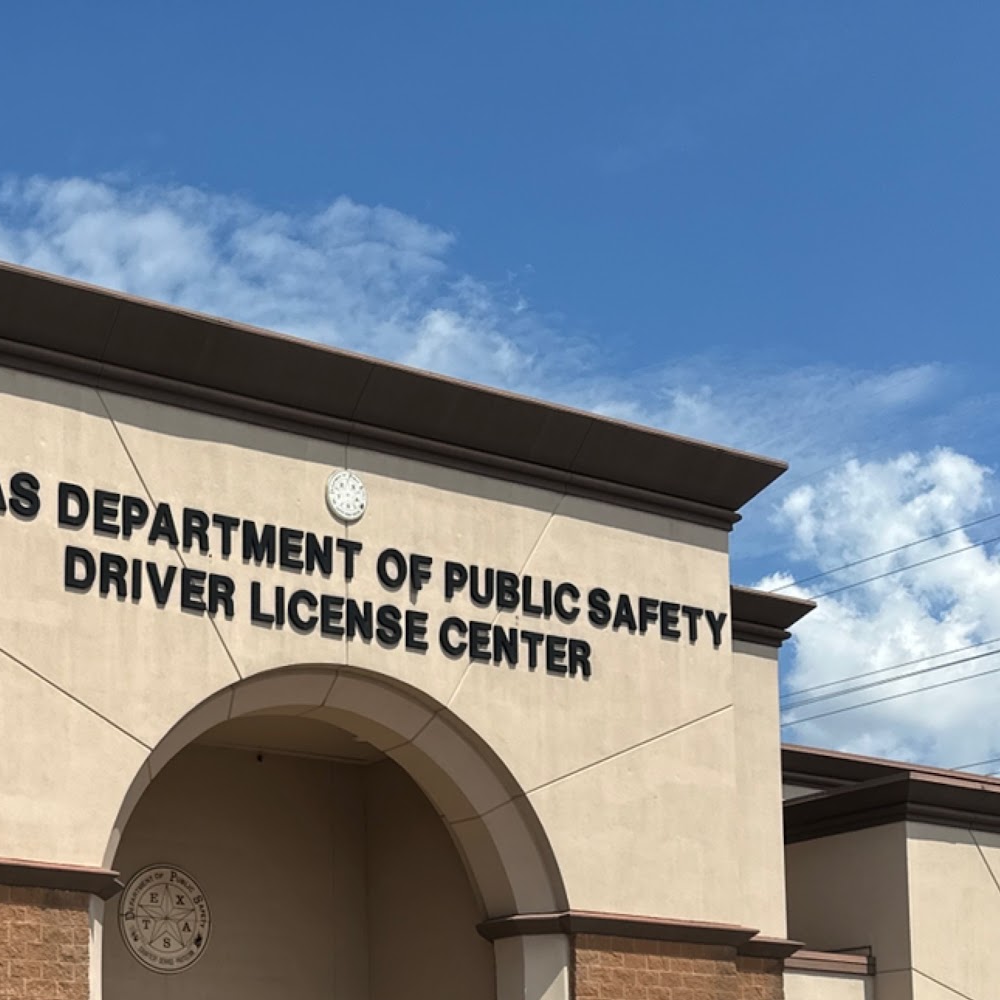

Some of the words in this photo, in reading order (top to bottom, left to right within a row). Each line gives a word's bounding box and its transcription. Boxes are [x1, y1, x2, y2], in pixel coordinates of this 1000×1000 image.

[58, 481, 362, 579] DEPARTMENT
[377, 547, 432, 591] OF
[445, 561, 580, 620] PUBLIC
[588, 587, 727, 646] SAFETY
[65, 545, 236, 617] DRIVER
[250, 581, 428, 650] LICENSE
[439, 616, 592, 677] CENTER
